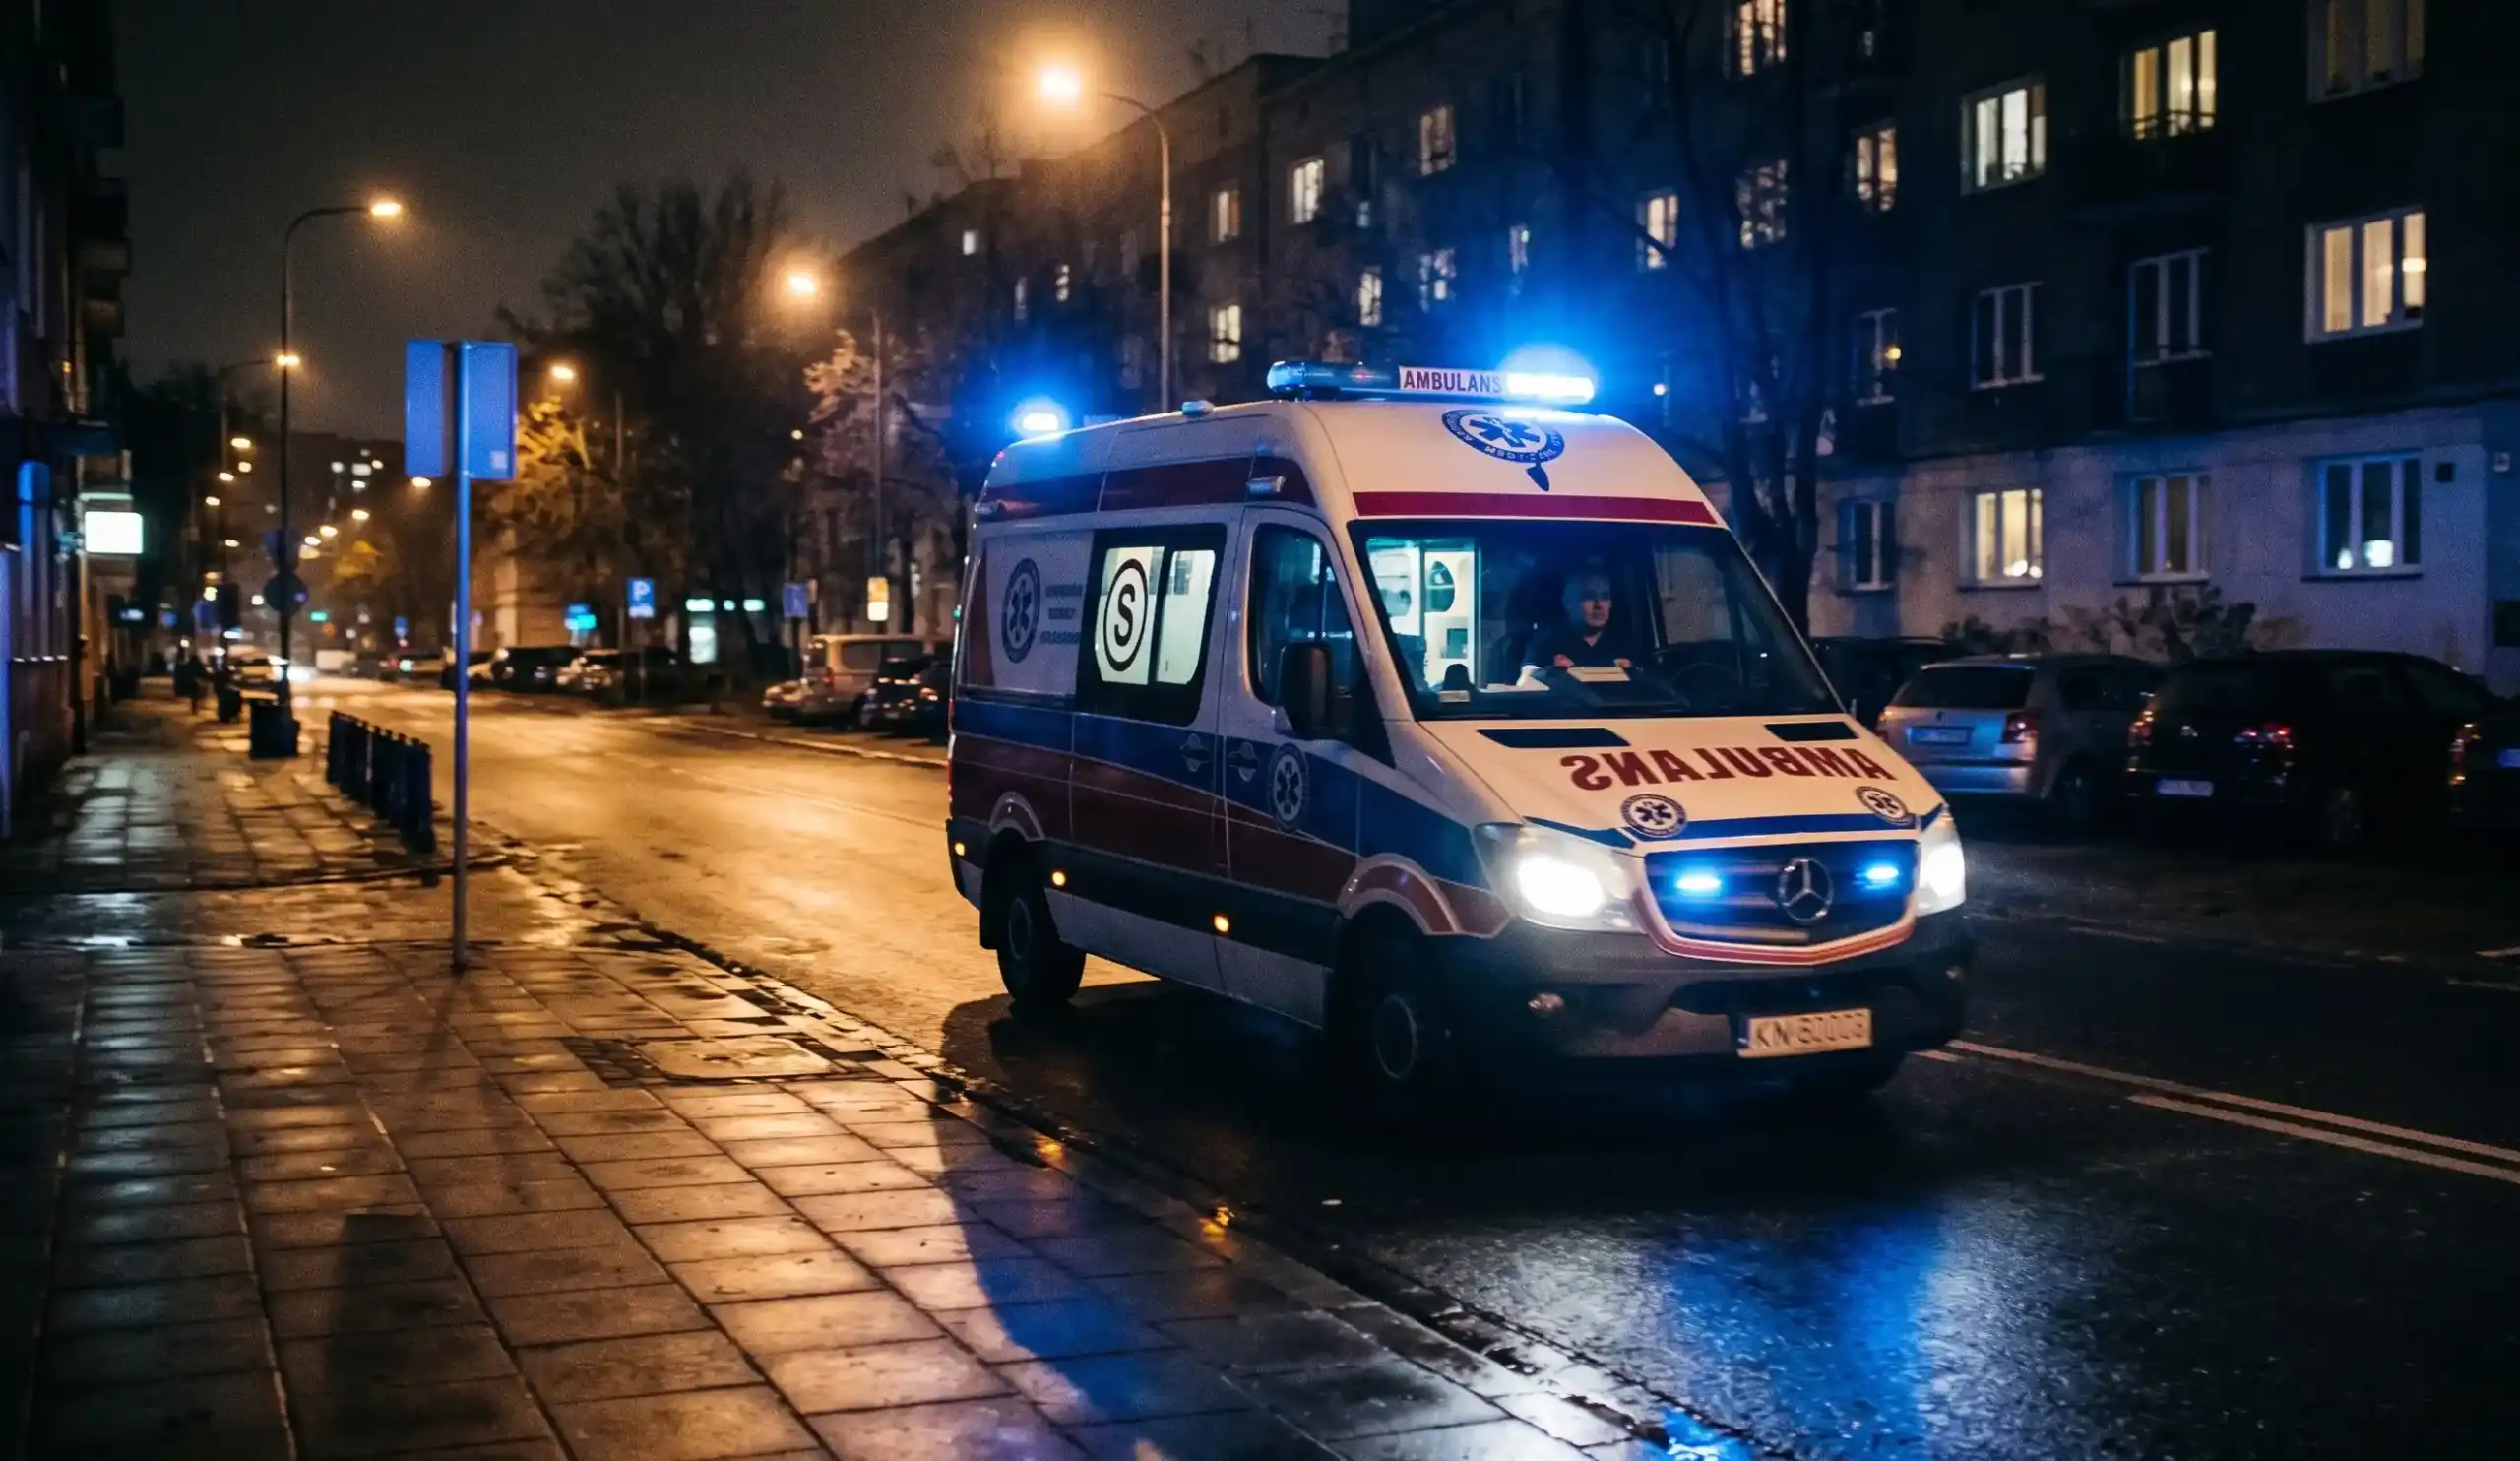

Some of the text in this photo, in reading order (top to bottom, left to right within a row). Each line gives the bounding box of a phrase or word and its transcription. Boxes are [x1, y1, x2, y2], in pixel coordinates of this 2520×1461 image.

[1403, 370, 1502, 393] AMBULANS
[632, 580, 651, 601] P
[1113, 583, 1136, 647] S
